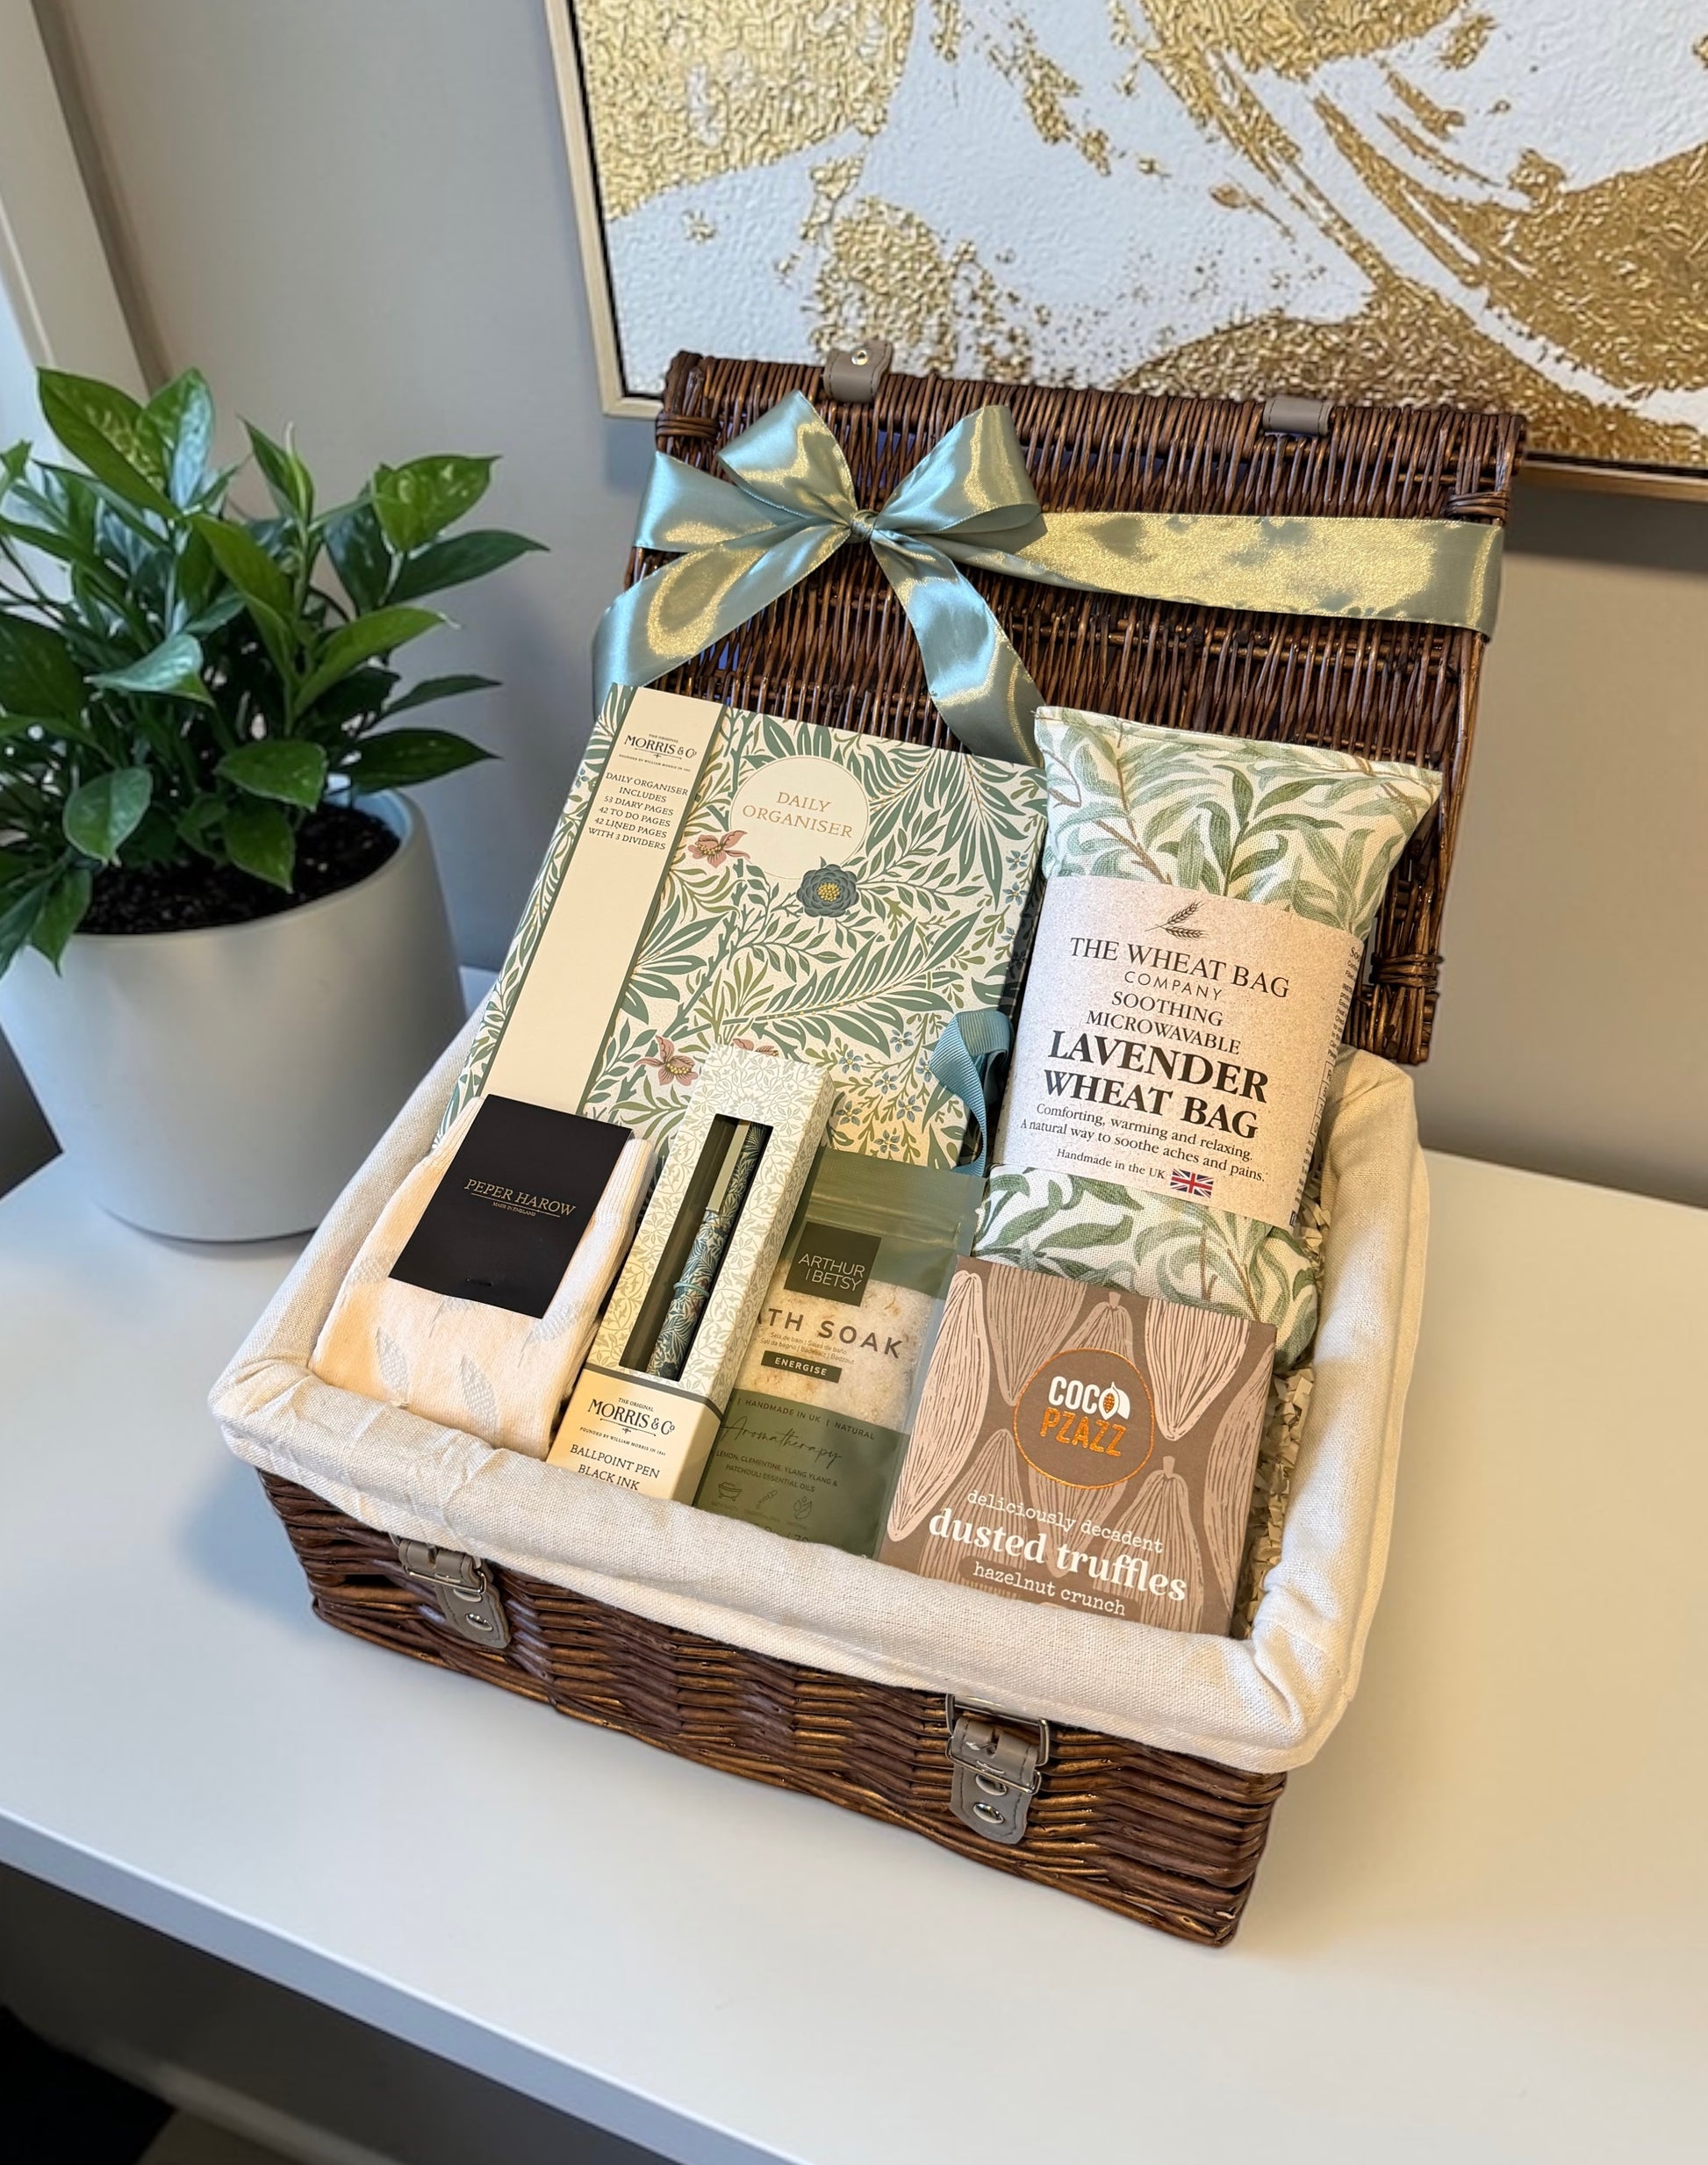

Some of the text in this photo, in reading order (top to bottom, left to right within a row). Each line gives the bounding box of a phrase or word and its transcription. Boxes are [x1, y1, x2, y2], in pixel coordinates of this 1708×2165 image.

[624, 735, 676, 755] MORRIS
[677, 746, 685, 756] &
[606, 772, 689, 796] DAILY ORGANISER
[619, 787, 667, 803] INCLUDES
[610, 809, 623, 817] TO
[624, 811, 640, 821] DO
[641, 815, 671, 827] PAGES
[614, 797, 643, 809] DIARY
[643, 803, 674, 816] PAGES
[775, 791, 832, 813] DAILY
[605, 819, 635, 831] LINED
[637, 825, 668, 838] PAGES
[743, 804, 854, 838] ORGANISER
[589, 827, 614, 839] WITH
[621, 834, 666, 851] DIVIDERS
[1070, 937, 1290, 999] THE WHEAT BAG
[1124, 970, 1224, 1002] COMPANY
[1112, 990, 1224, 1028] SOOTHING
[1086, 1010, 1241, 1056] MICROWAVABLE
[1047, 1030, 1269, 1104] LAVENDER
[1043, 1068, 1173, 1116] WHEAT
[1181, 1096, 1259, 1140] BAG
[1037, 1103, 1253, 1162] Comforting, warming and relaxing.
[1020, 1118, 1266, 1183] A natural way to soothe aches and pains.
[1056, 1148, 1166, 1179] Handmade in the UK
[464, 1178, 577, 1217] PEPER HAROW
[798, 1253, 865, 1278] ARTHUR
[812, 1270, 863, 1291] BETSY
[817, 1320, 903, 1359] SOAK
[774, 1357, 828, 1376] ENERGISE
[629, 1399, 654, 1412] ORIGINAL
[1048, 1375, 1131, 1421] COCO
[587, 1399, 650, 1429] MORRIS
[651, 1417, 659, 1431] &
[744, 1399, 876, 1441] HANDMADE IN UK NATURAL
[579, 1427, 603, 1437] FOUNDED
[610, 1435, 630, 1445] WILLIAM
[631, 1441, 649, 1451] MORRIS
[719, 1415, 843, 1470] Aromatherapy
[1039, 1406, 1127, 1457] PZAZZ
[570, 1443, 660, 1478] BALLPOINT PEN
[784, 1466, 807, 1478] YLANG
[808, 1472, 832, 1485] YLANG
[578, 1464, 640, 1491] BLACK INK
[726, 1464, 815, 1492] PATCHOULI ESSENTIAL OILS
[966, 1489, 1164, 1555] deliciously decadent
[929, 1508, 1187, 1602] dusted truffles
[972, 1560, 1128, 1617] hazelnut crunch
